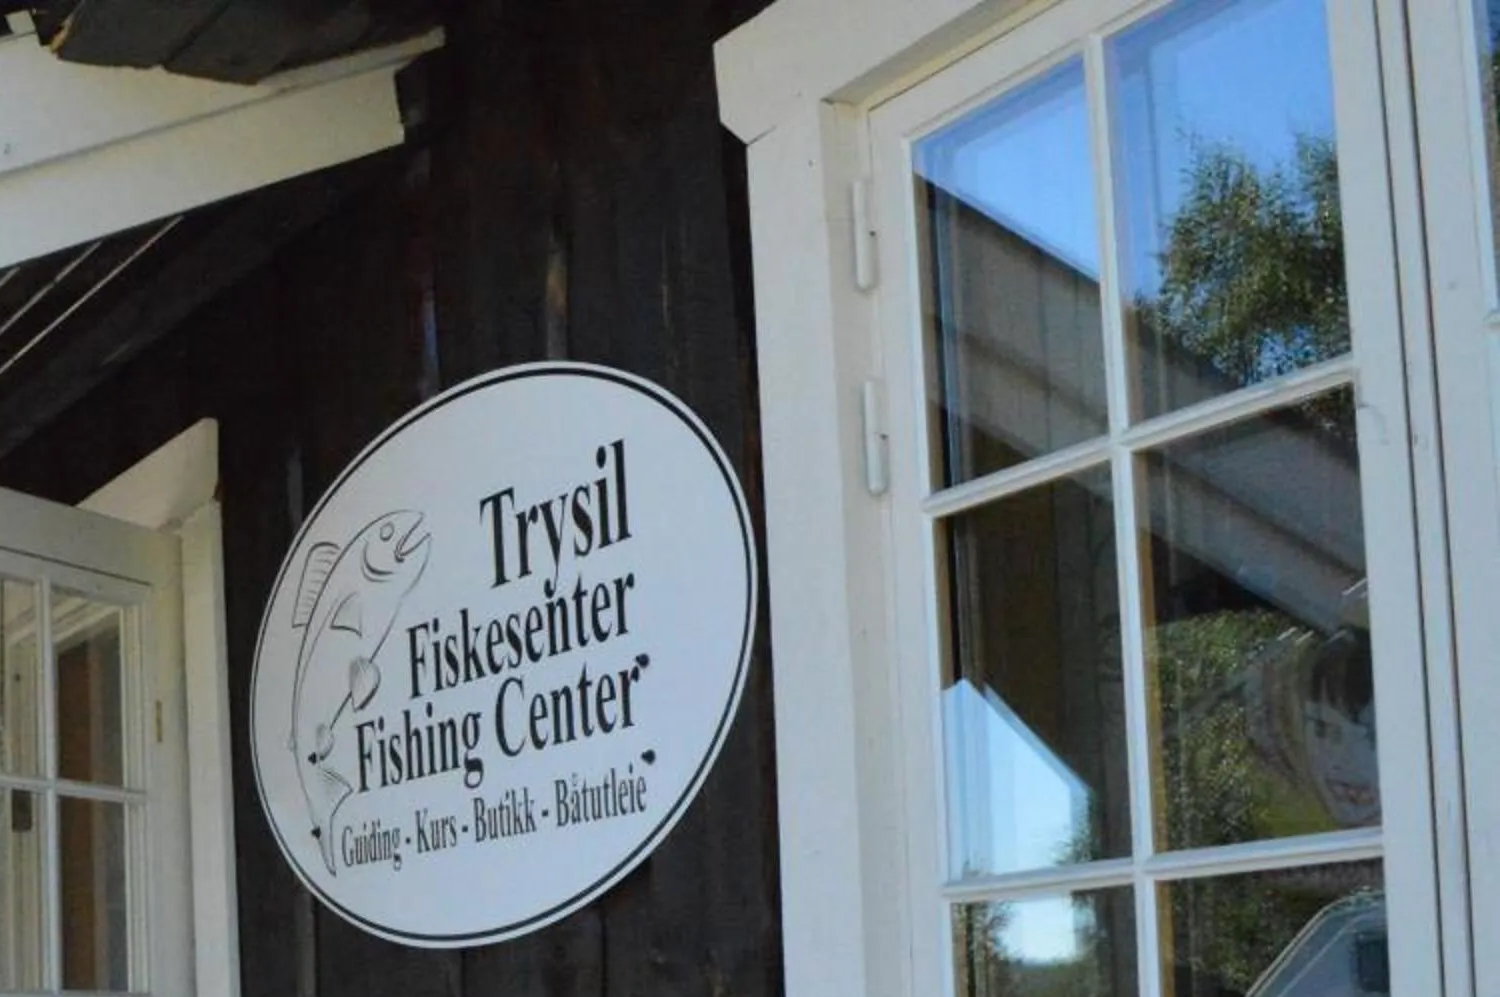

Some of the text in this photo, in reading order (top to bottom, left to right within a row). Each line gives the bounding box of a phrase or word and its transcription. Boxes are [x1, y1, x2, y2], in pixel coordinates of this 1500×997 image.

[479, 438, 632, 597] Trysil
[406, 572, 636, 698] Fiskesenter
[355, 661, 641, 789] Fishing Center
[341, 820, 402, 871] Guiding
[414, 808, 458, 854] Kurs
[472, 786, 538, 844] Butikk
[554, 763, 648, 829] Båtutleie
